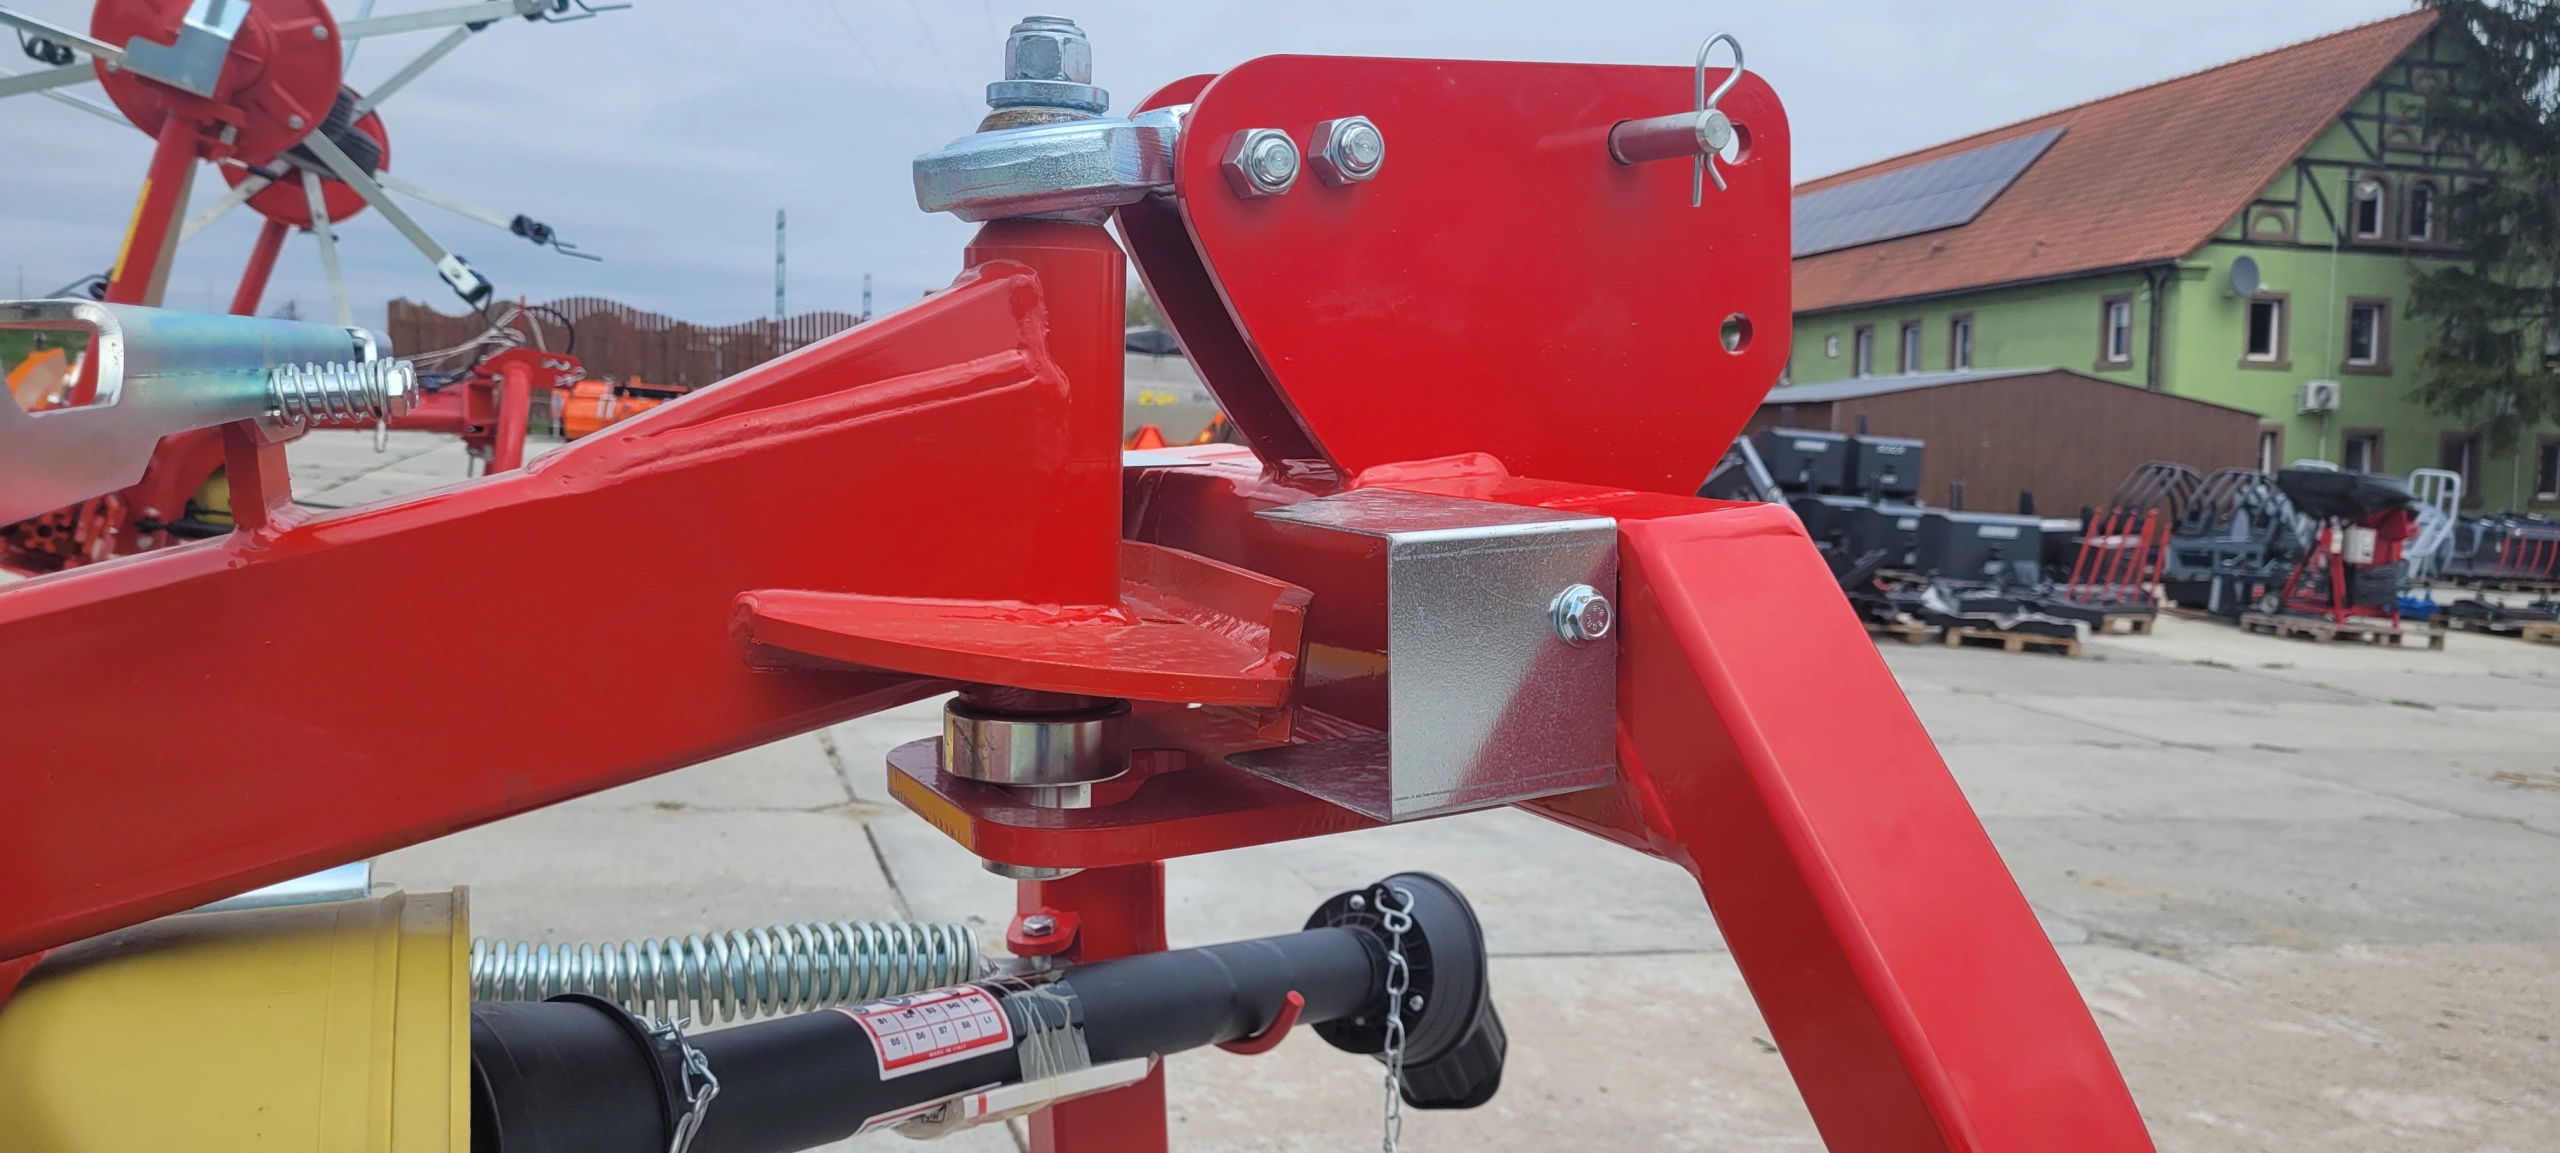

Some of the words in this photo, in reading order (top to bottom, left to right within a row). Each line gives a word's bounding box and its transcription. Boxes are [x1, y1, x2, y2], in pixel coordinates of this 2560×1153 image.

[984, 1016, 992, 1024] L1
[938, 1026, 948, 1035] B7
[891, 1038, 901, 1046] B5
